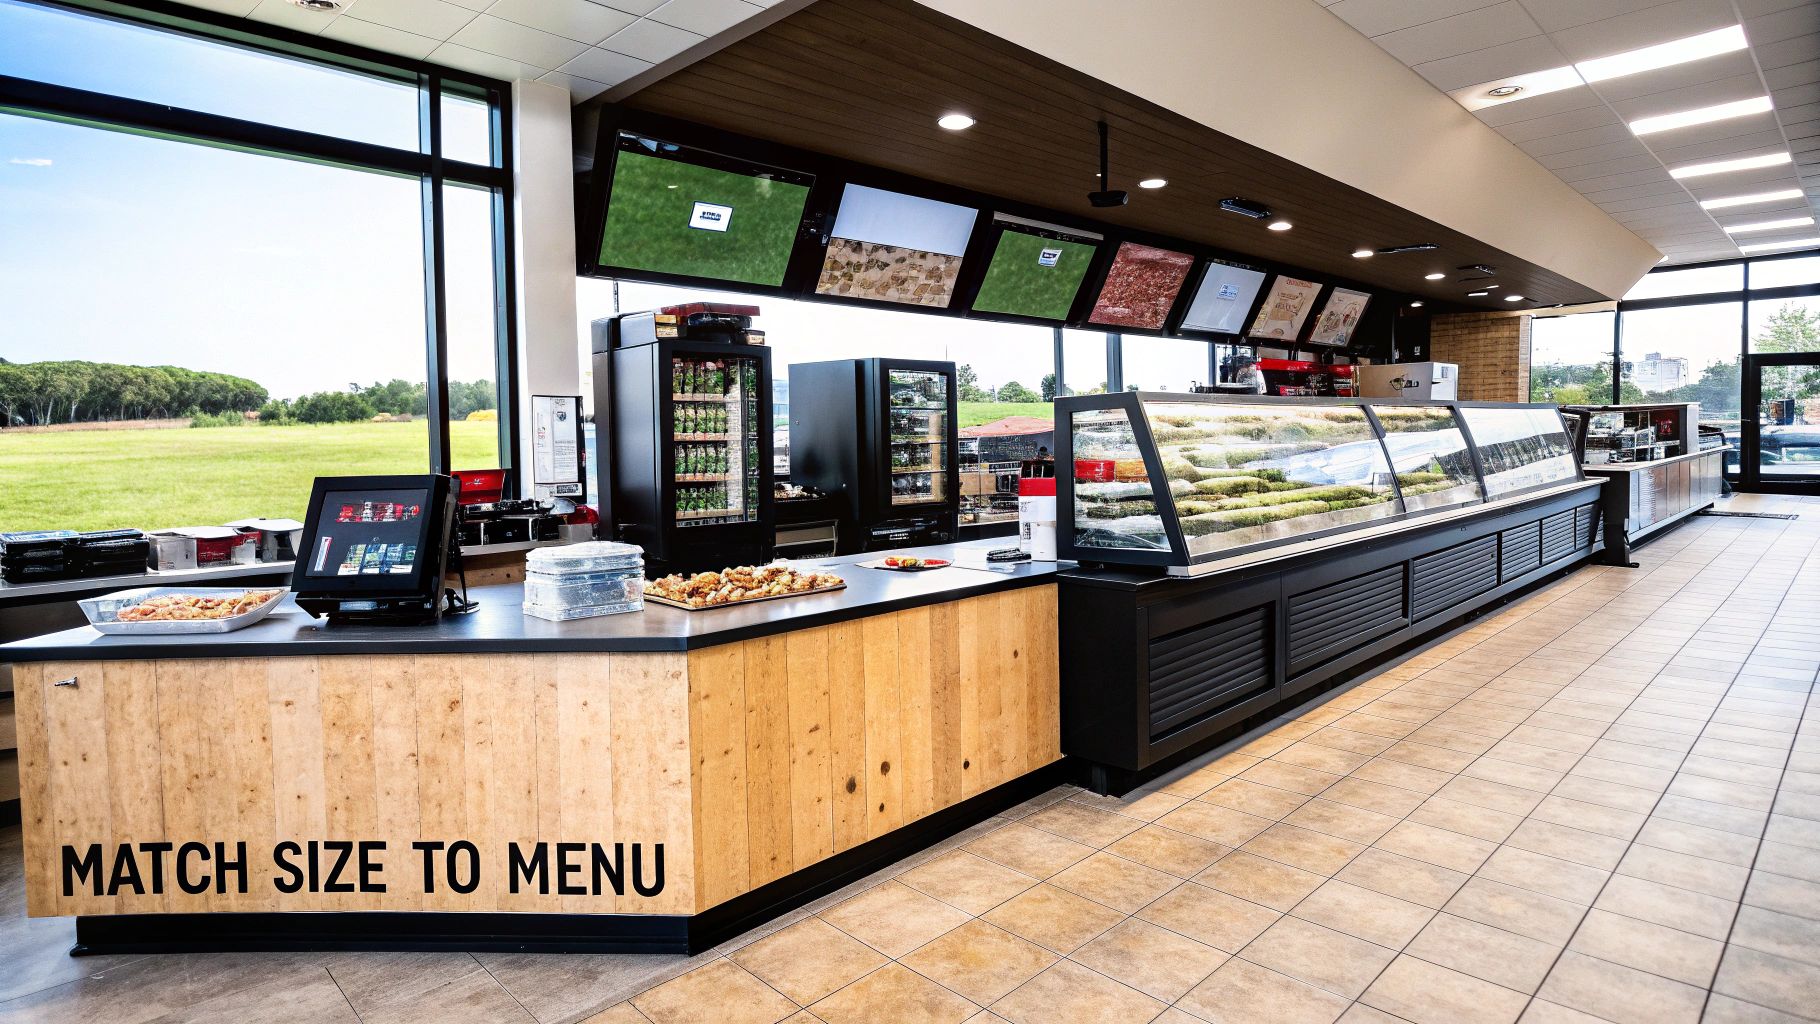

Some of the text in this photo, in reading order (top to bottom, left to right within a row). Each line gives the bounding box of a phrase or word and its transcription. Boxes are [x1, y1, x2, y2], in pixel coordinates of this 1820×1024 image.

[61, 840, 665, 898] MATCH SIZE TO MENU
